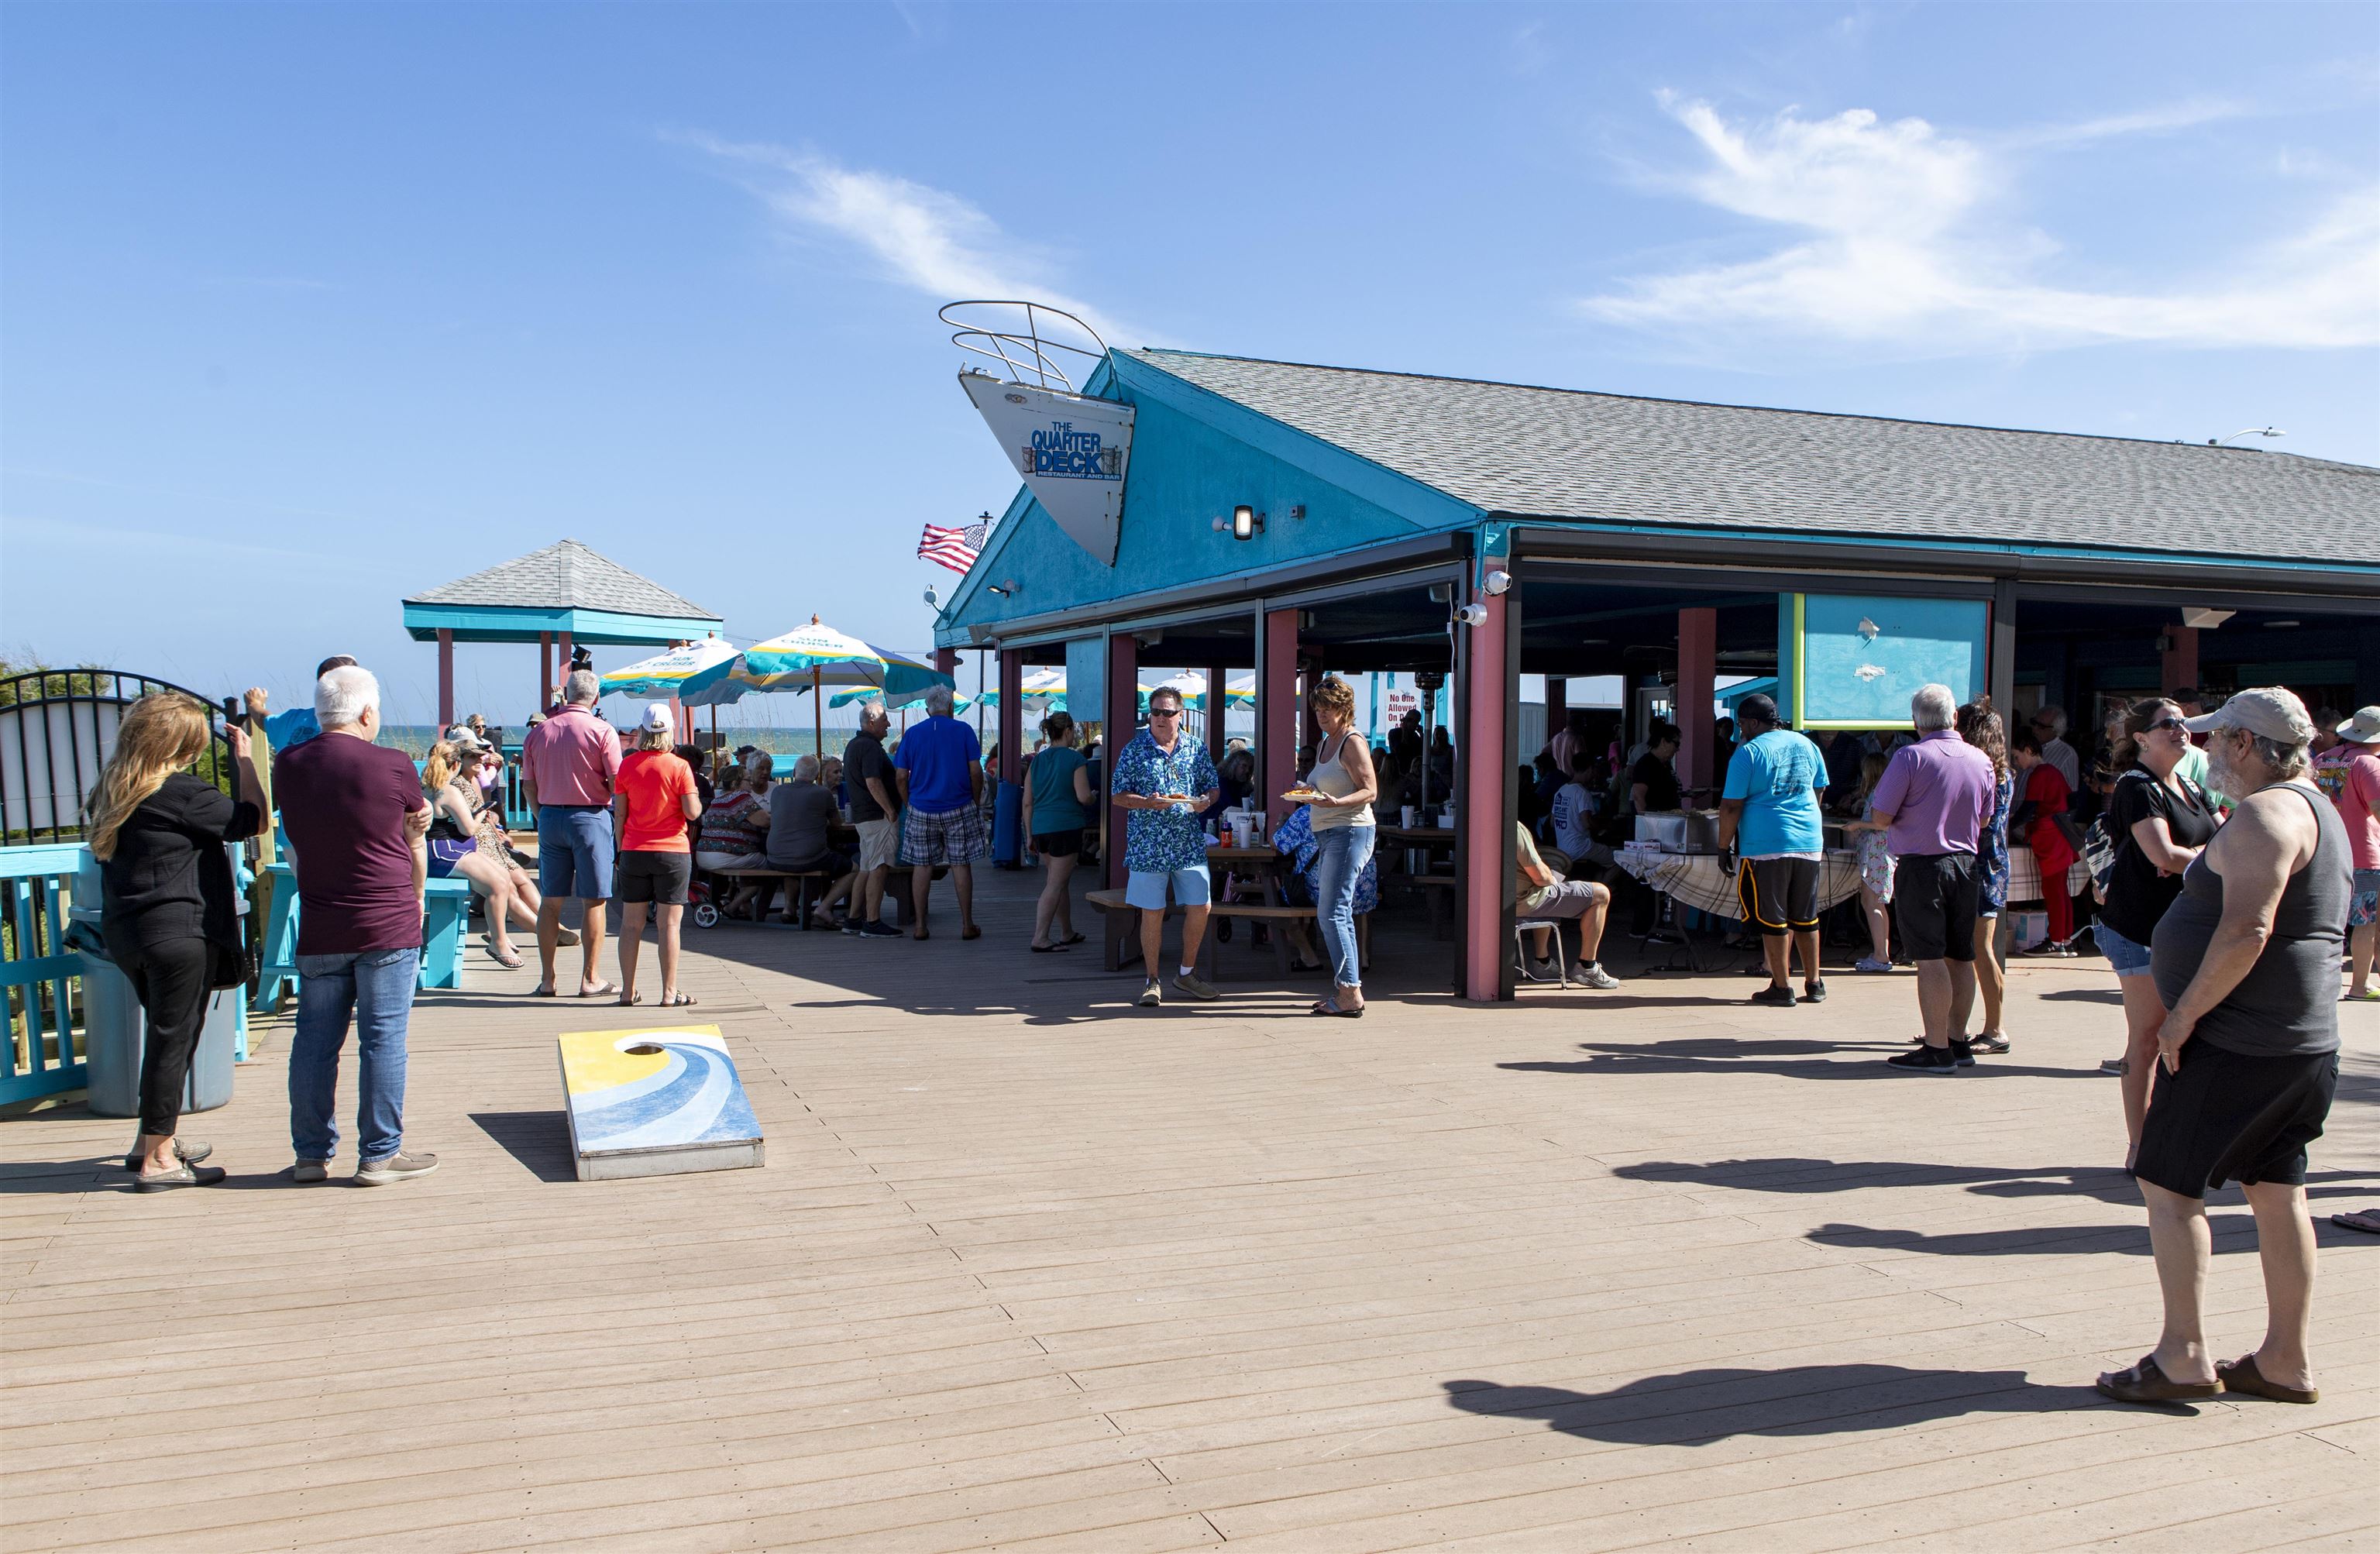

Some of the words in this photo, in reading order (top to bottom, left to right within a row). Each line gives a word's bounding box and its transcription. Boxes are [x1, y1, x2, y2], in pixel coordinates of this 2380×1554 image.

[1051, 421, 1072, 432] THE
[1031, 430, 1101, 452] QUARTER
[1035, 450, 1104, 473] DECK
[781, 639, 844, 648] CRUISER
[1389, 694, 1399, 703] No
[1402, 694, 1415, 703] One
